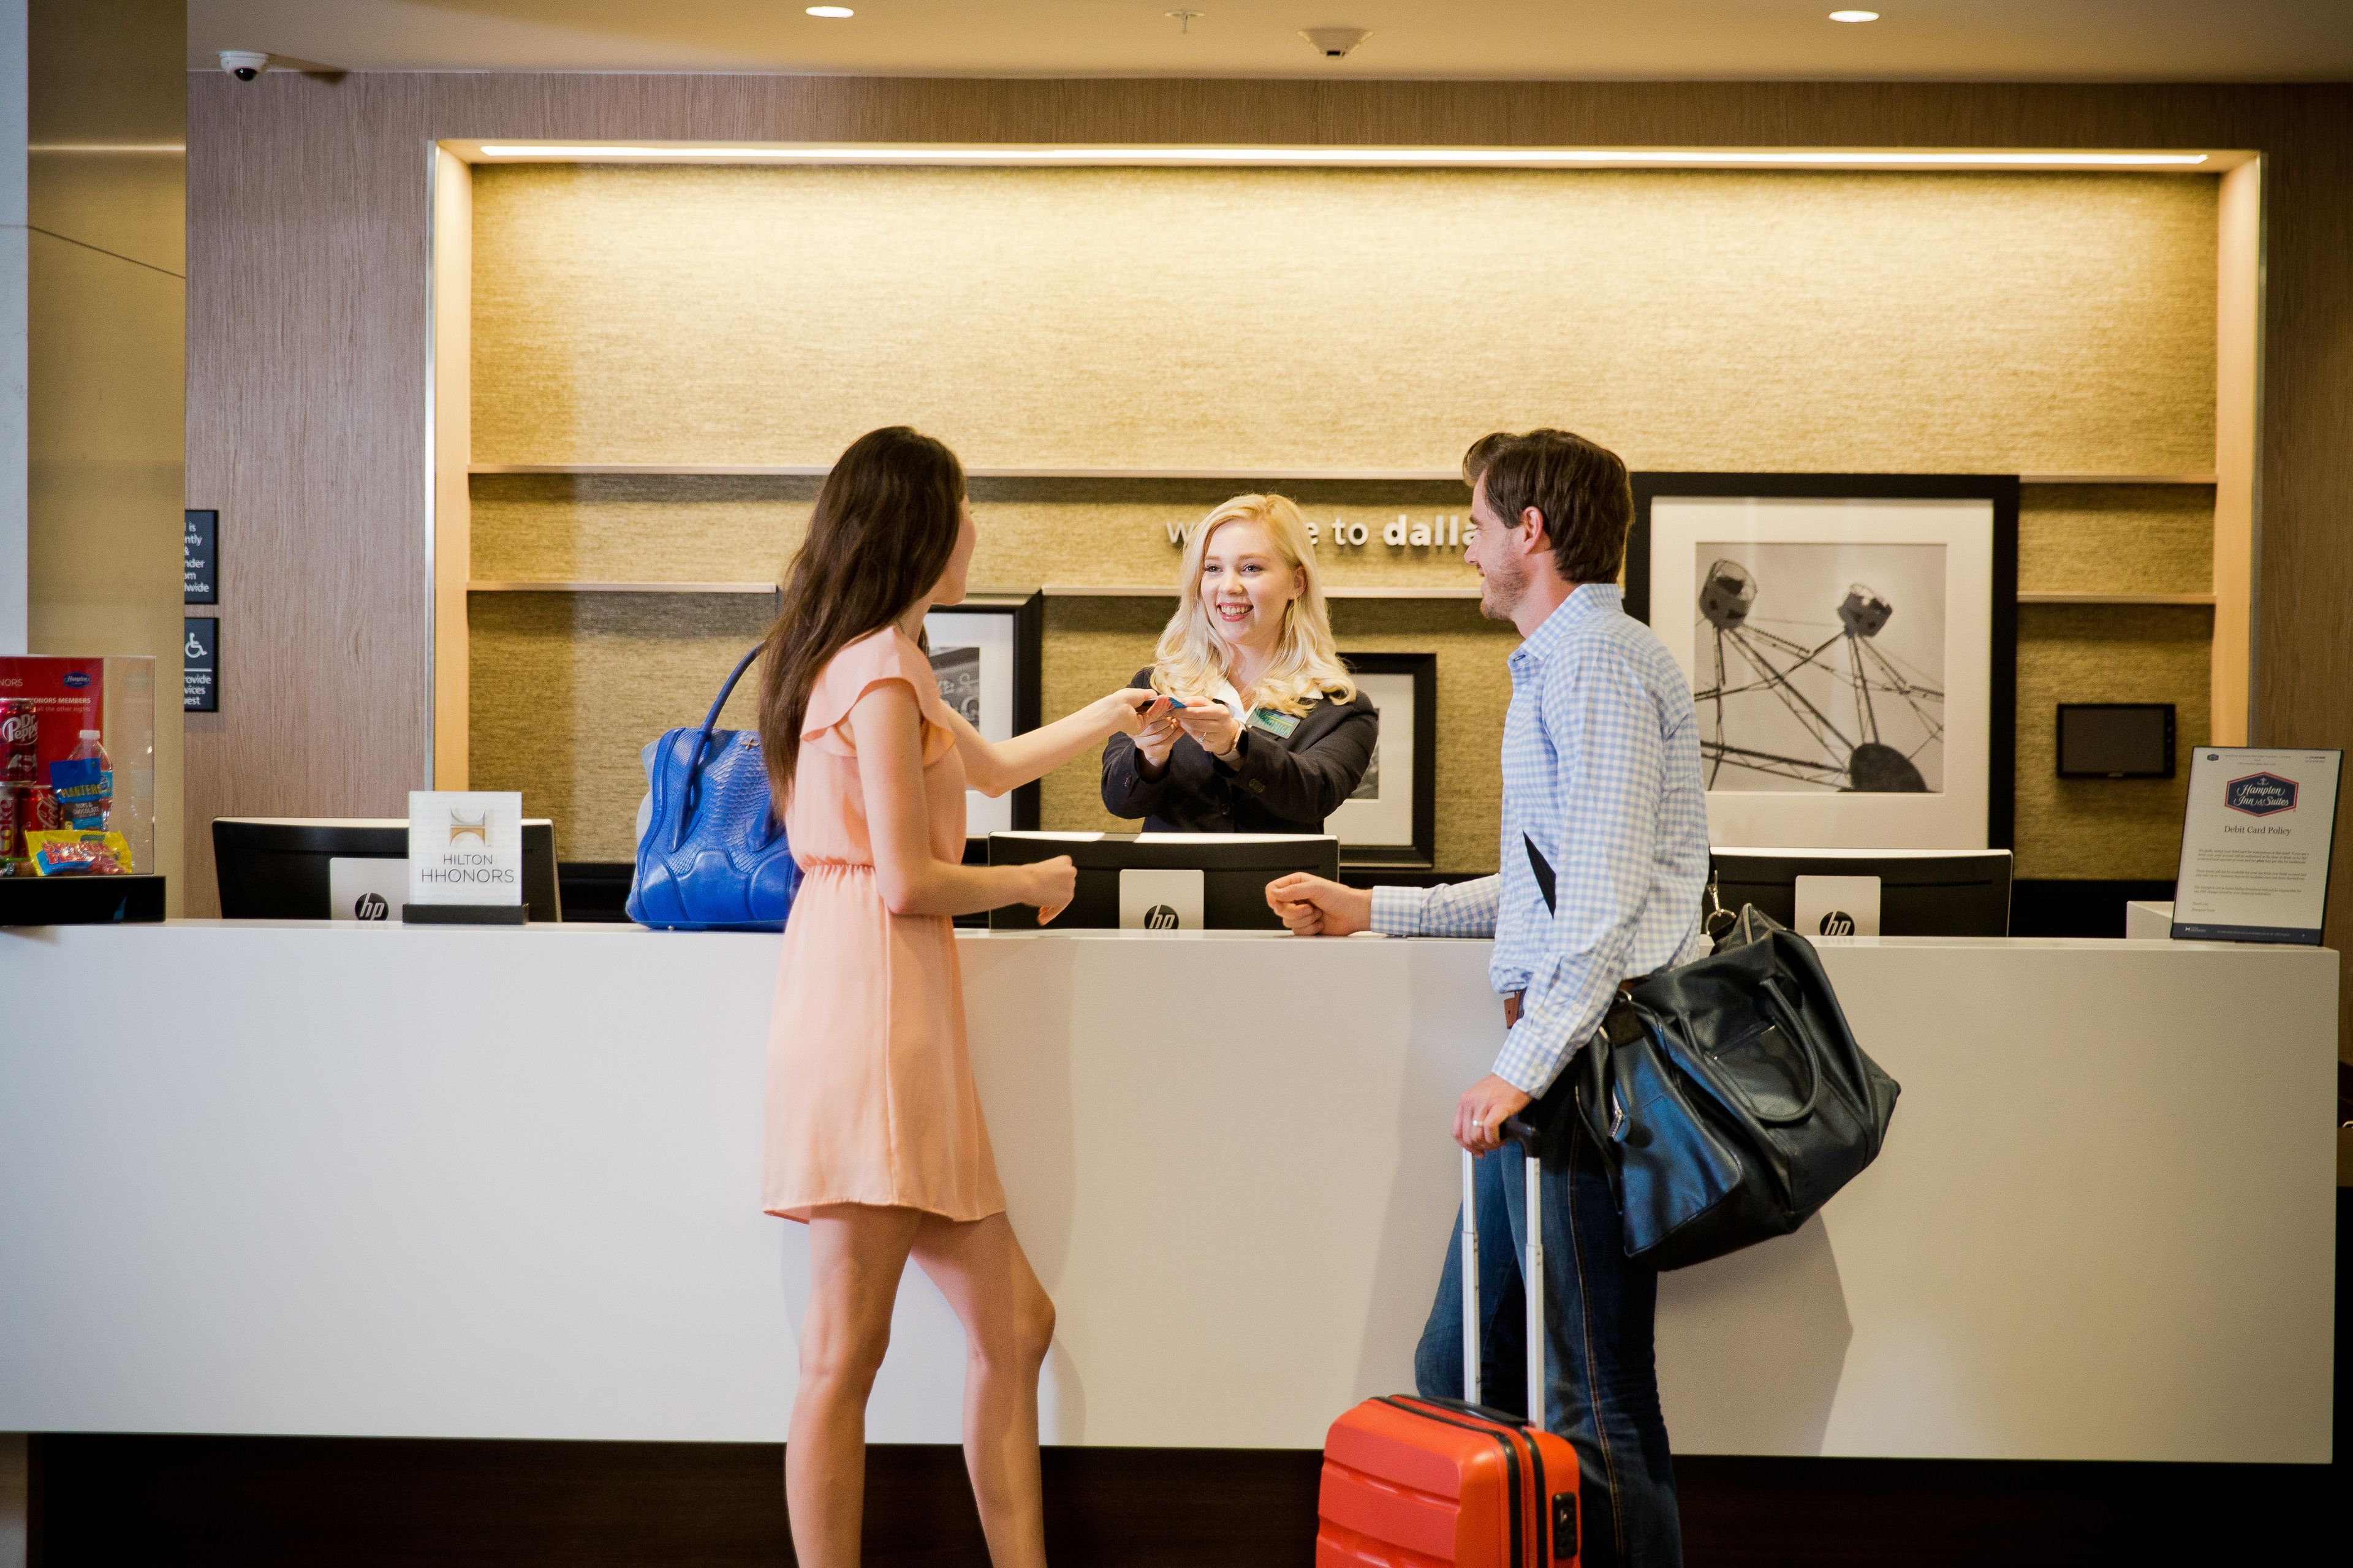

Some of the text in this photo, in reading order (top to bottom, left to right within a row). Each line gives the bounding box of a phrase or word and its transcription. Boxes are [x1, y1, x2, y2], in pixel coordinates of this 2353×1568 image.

[188, 521, 196, 532] is
[1332, 517, 1368, 546] to
[1383, 514, 1479, 546] dalla
[21, 713, 36, 729] Dr
[2, 717, 38, 743] Peppe
[60, 784, 102, 798] PLANTERS
[2237, 784, 2286, 796] Hampton
[2234, 796, 2257, 806] Inn
[2263, 796, 2289, 806] Suites
[2224, 825, 2292, 836] Debit Card Policy
[443, 854, 493, 866] HILTON
[421, 868, 515, 884] HHONORS
[359, 892, 385, 921] hp
[1148, 904, 1176, 930] hp
[1824, 911, 1851, 936] hp
